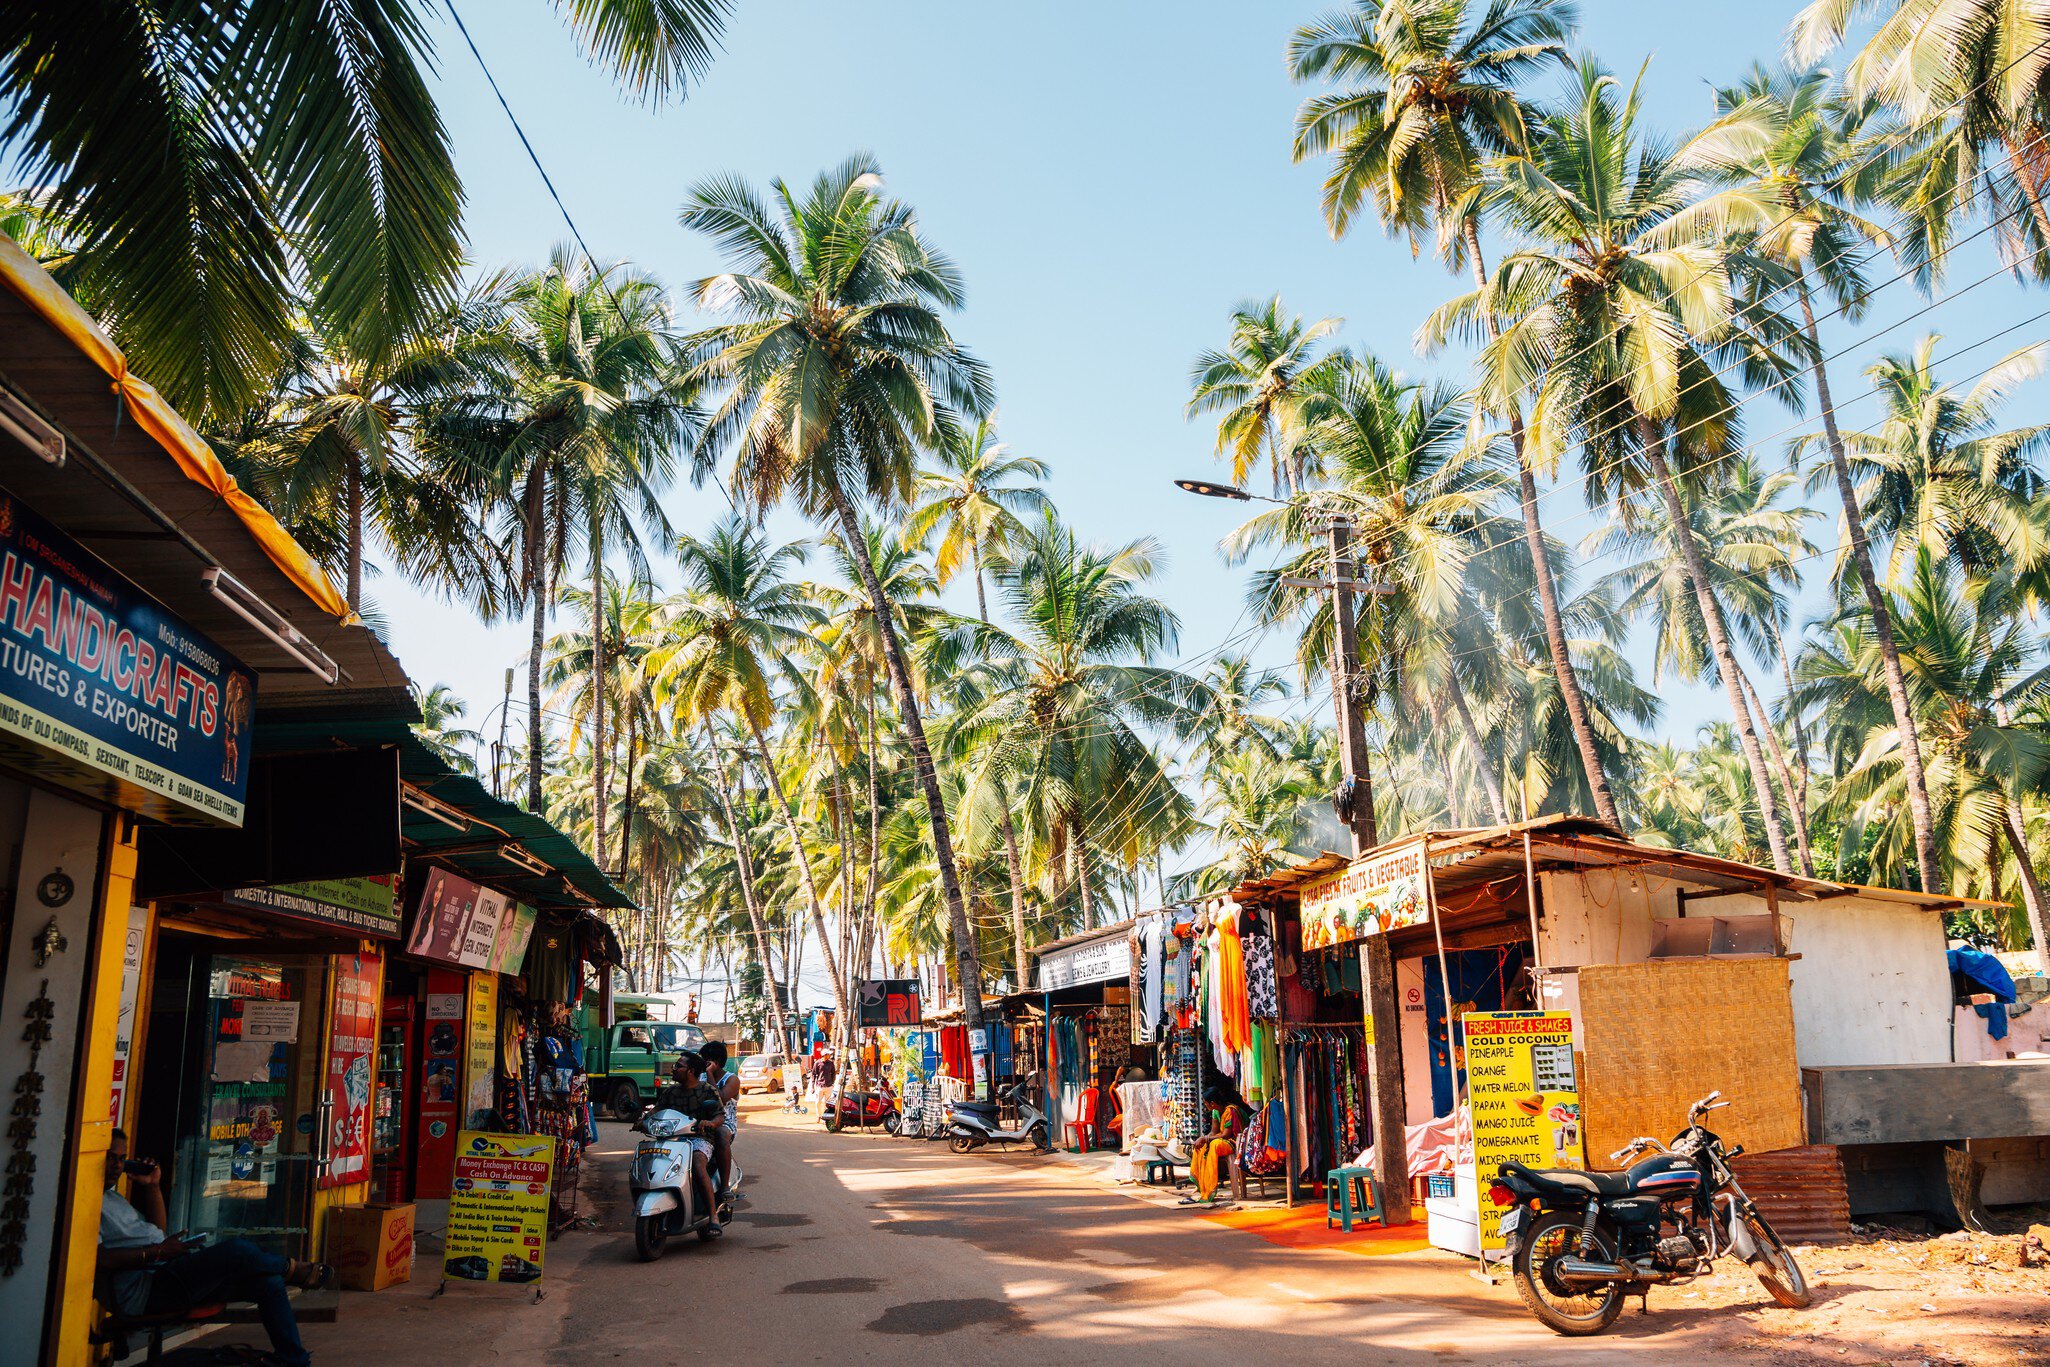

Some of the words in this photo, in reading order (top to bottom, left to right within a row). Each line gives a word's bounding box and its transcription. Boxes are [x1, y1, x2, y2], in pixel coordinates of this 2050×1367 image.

[0, 550, 219, 738] HANDICRAFTS
[1, 637, 71, 698] TURES
[73, 679, 88, 709] &
[91, 688, 178, 753] EXPORTER
[0, 702, 20, 725] INDS
[21, 713, 33, 731] OF
[34, 719, 51, 739] OLD
[135, 764, 165, 788] TELSCOPE
[1342, 870, 1367, 897] FRUITS
[1368, 868, 1374, 888] &
[1376, 852, 1420, 886] VEGETABLE
[234, 887, 266, 903] DOMESTIC
[274, 893, 317, 915] INTERNATIONAL
[887, 993, 919, 1025] RI
[1468, 1021, 1497, 1034] FRESH
[1499, 1020, 1525, 1033] JUICE
[1527, 1020, 1533, 1032] &
[1535, 1019, 1569, 1032] SHAKES
[1471, 1037, 1505, 1046] COLD
[1508, 1034, 1569, 1044] COCONUT
[1470, 1047, 1514, 1059] PINEAPPLE
[1472, 1065, 1506, 1077] ORANGE
[1473, 1083, 1501, 1094] WATER
[1503, 1082, 1531, 1092] MELON
[1474, 1100, 1506, 1111] PAPAYA
[1476, 1118, 1508, 1129] MANGO
[1509, 1116, 1535, 1128] JUICE
[210, 1124, 235, 1140] MOBILE
[1477, 1134, 1540, 1147] POMEGRANATE
[460, 1158, 482, 1169] Money
[482, 1160, 512, 1171] Exchange
[513, 1162, 521, 1171] TC
[522, 1163, 528, 1171] &
[528, 1163, 546, 1173] CASH
[1478, 1154, 1508, 1165] MIXED
[1509, 1153, 1541, 1164] FRUITS
[469, 1170, 488, 1179] Cash
[489, 1171, 500, 1179] On
[502, 1171, 534, 1181] Advance
[503, 1193, 514, 1201] Card
[456, 1201, 479, 1209] Domestic
[484, 1202, 515, 1212] International
[515, 1205, 529, 1214] Flight
[530, 1206, 546, 1214] Tickets
[463, 1212, 475, 1220] India
[503, 1215, 523, 1224] Booking
[468, 1224, 488, 1232] Booking
[453, 1233, 469, 1241] Mobile
